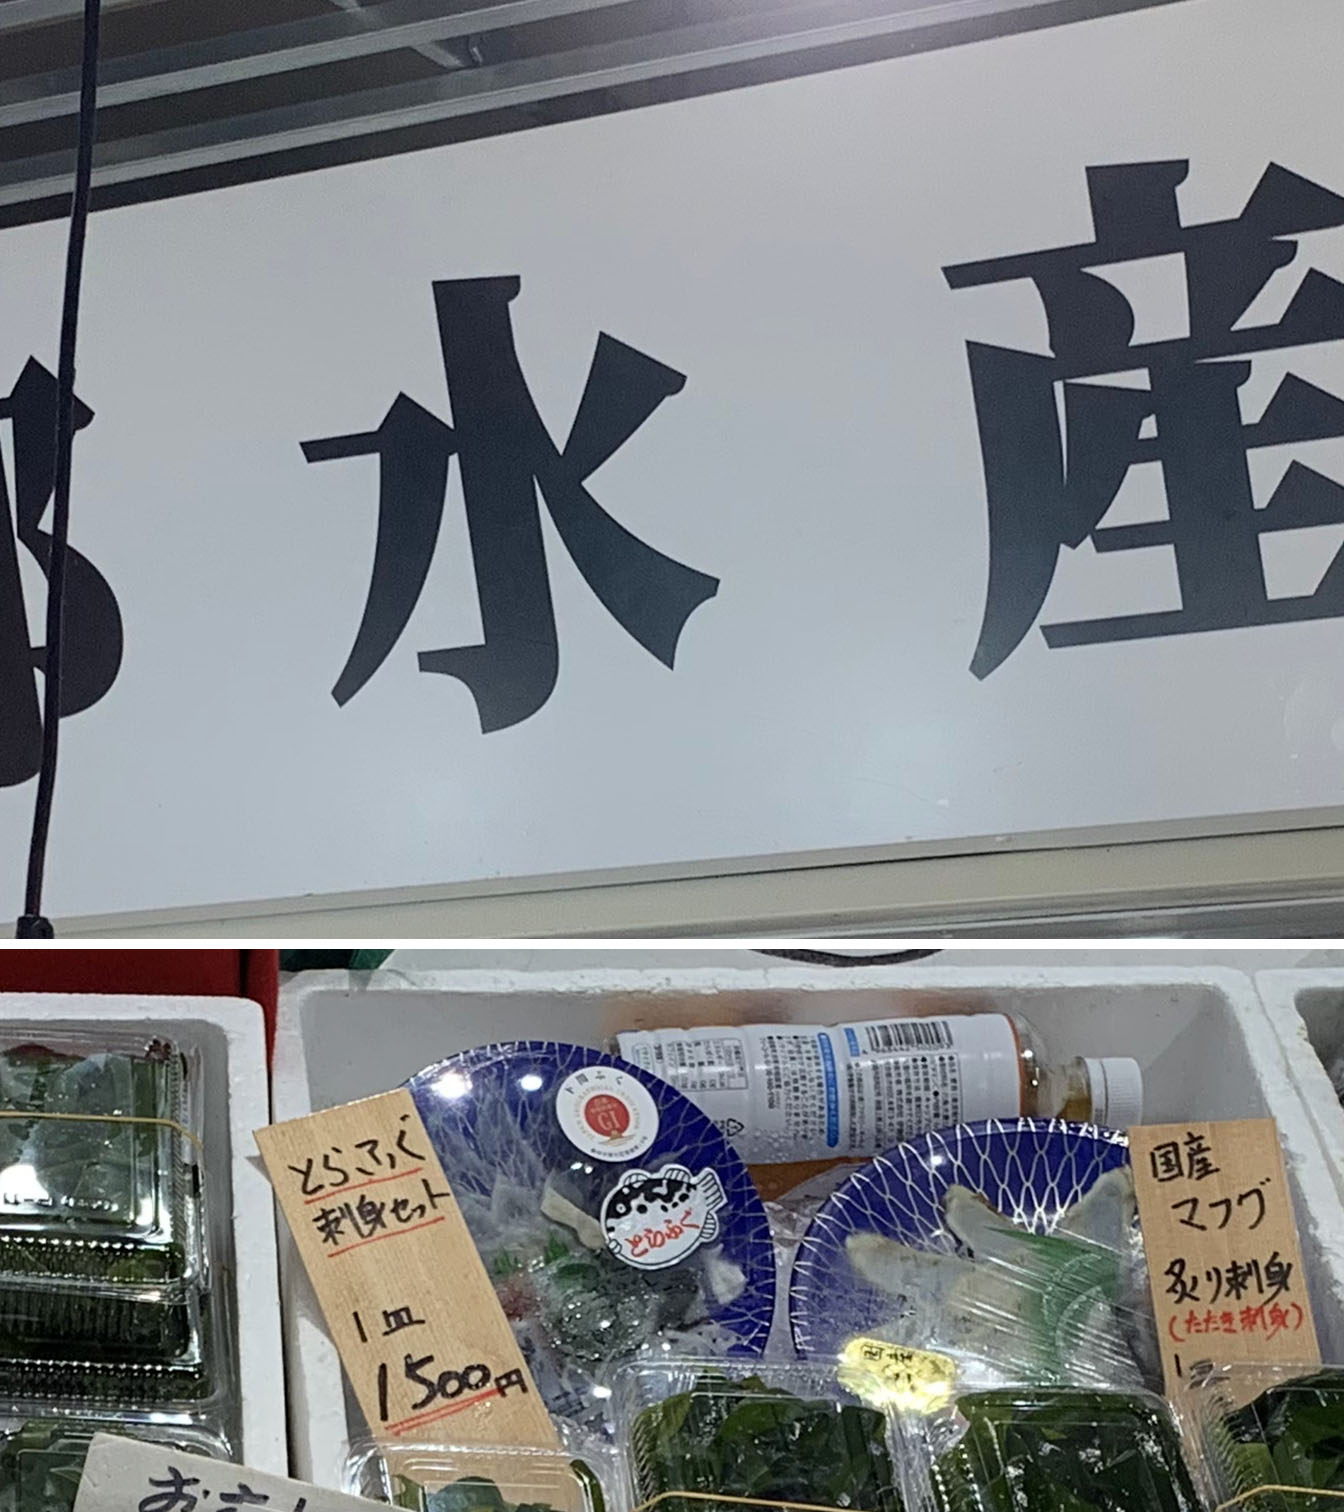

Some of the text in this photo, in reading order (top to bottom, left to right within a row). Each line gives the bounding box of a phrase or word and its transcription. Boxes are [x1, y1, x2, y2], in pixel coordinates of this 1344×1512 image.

[288, 1113, 427, 1196] とらふぐ
[1150, 1132, 1220, 1182] 国産
[312, 1178, 451, 1246] 刺身セット
[1171, 1176, 1272, 1231] マフグ
[1165, 1250, 1293, 1305] 炙り刺身
[352, 1305, 426, 1343] 1皿
[375, 1353, 528, 1421] 1500円
